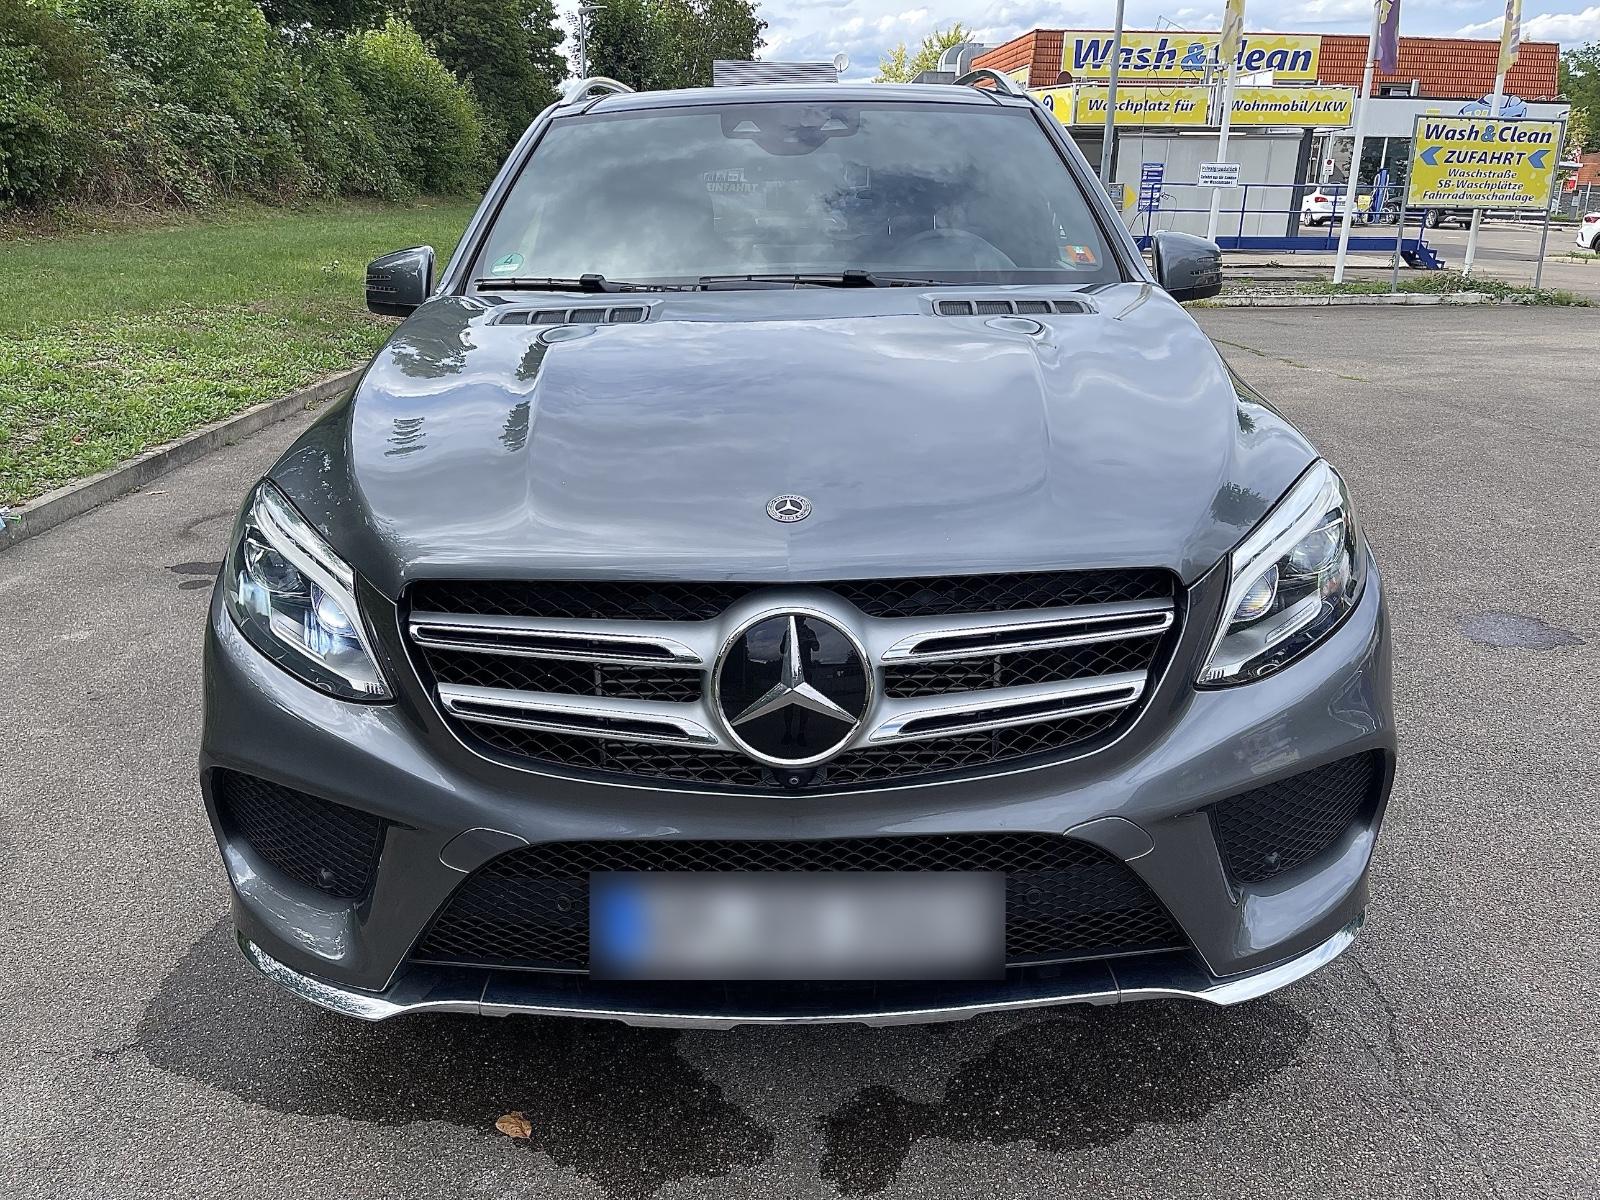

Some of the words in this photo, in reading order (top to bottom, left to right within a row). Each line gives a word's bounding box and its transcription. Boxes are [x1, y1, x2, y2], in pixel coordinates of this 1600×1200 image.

[1174, 99, 1196, 113] für
[1231, 99, 1348, 113] Wohnmobil/LKW
[1444, 150, 1526, 166] ZUFAHRT
[1448, 168, 1517, 179] Waschstraße
[1437, 179, 1524, 192] SB-Waschplätze
[1423, 190, 1534, 203] Fahrradwaschanlage
[504, 254, 513, 264] 4
